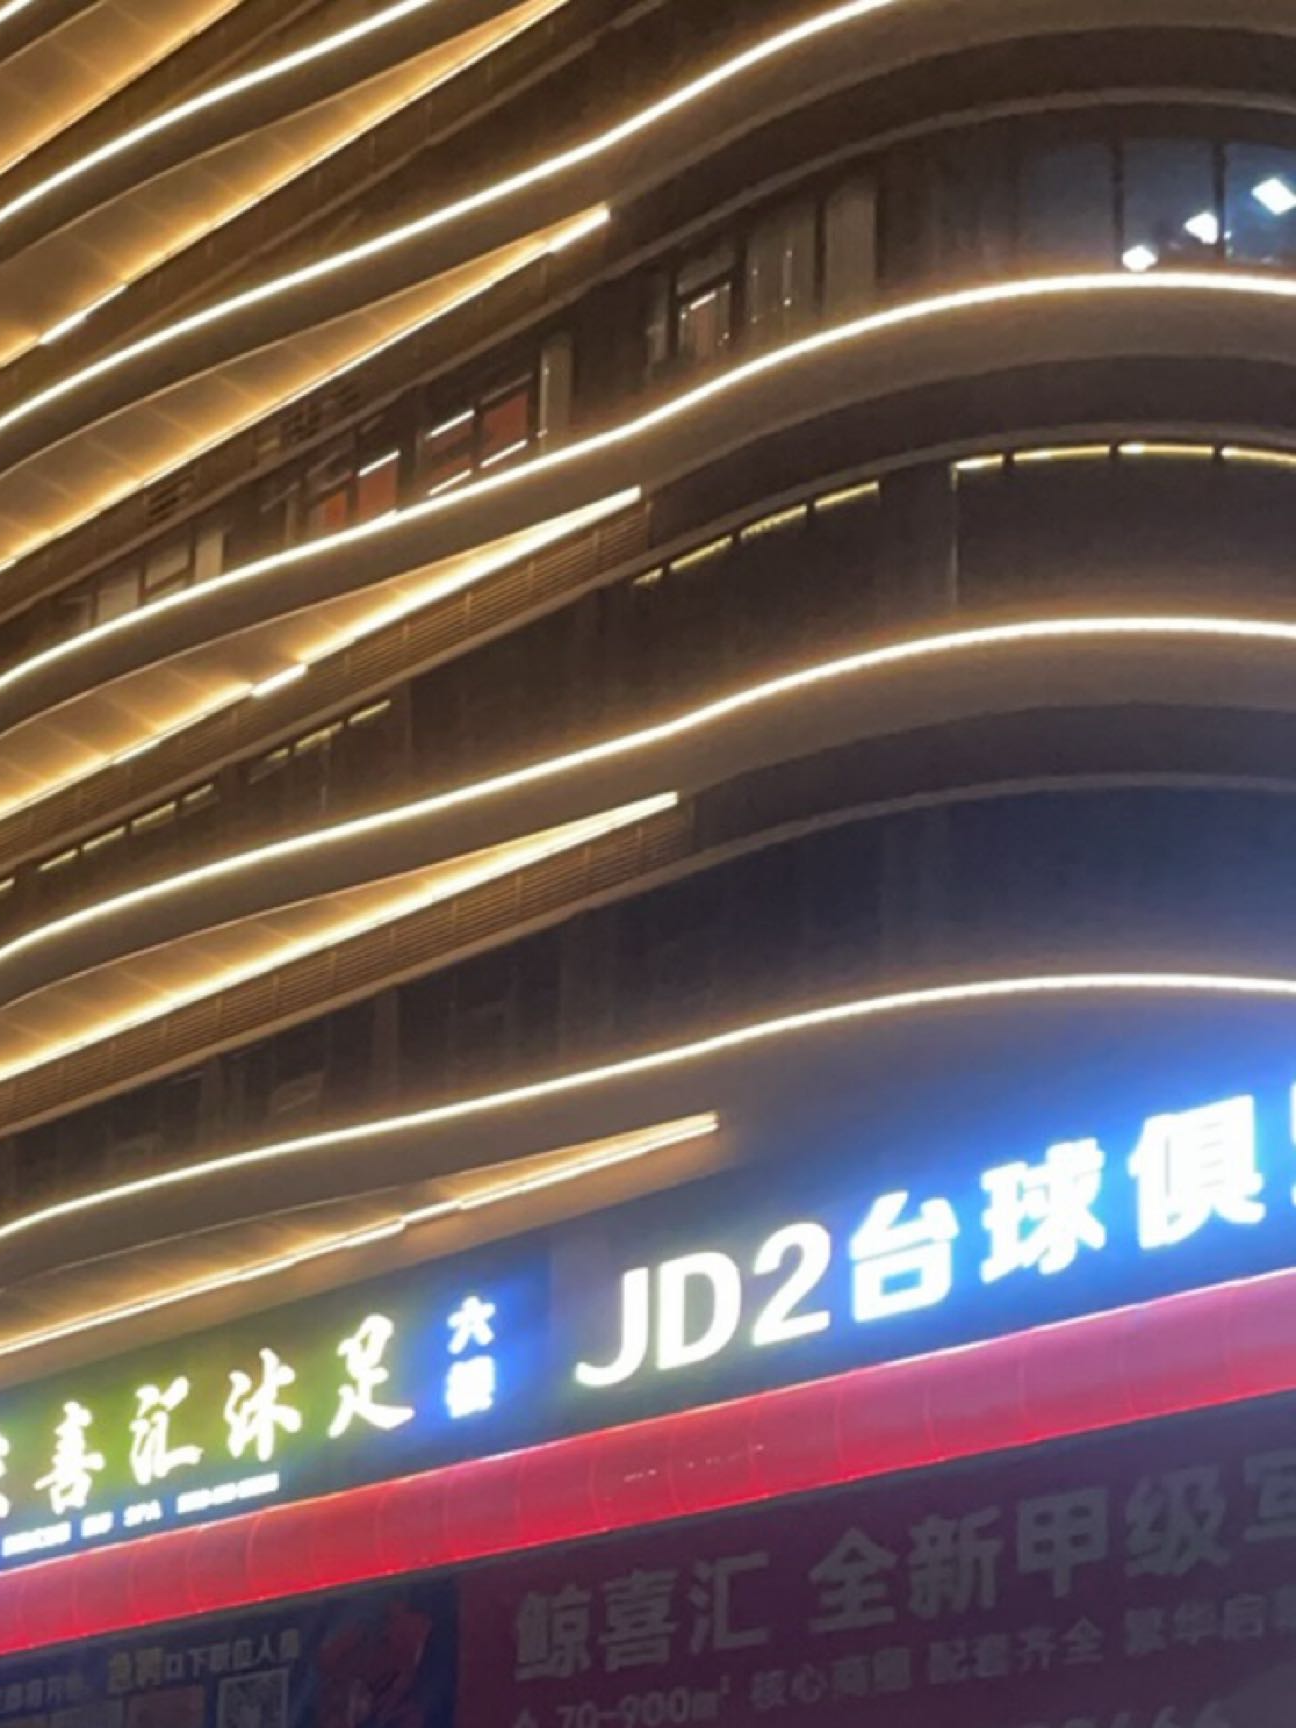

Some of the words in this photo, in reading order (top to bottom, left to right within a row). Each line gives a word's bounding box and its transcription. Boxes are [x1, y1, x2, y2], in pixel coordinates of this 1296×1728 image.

[573, 1082, 1296, 1389] JD2台球俱
[514, 1551, 772, 1682] 鲸喜汇
